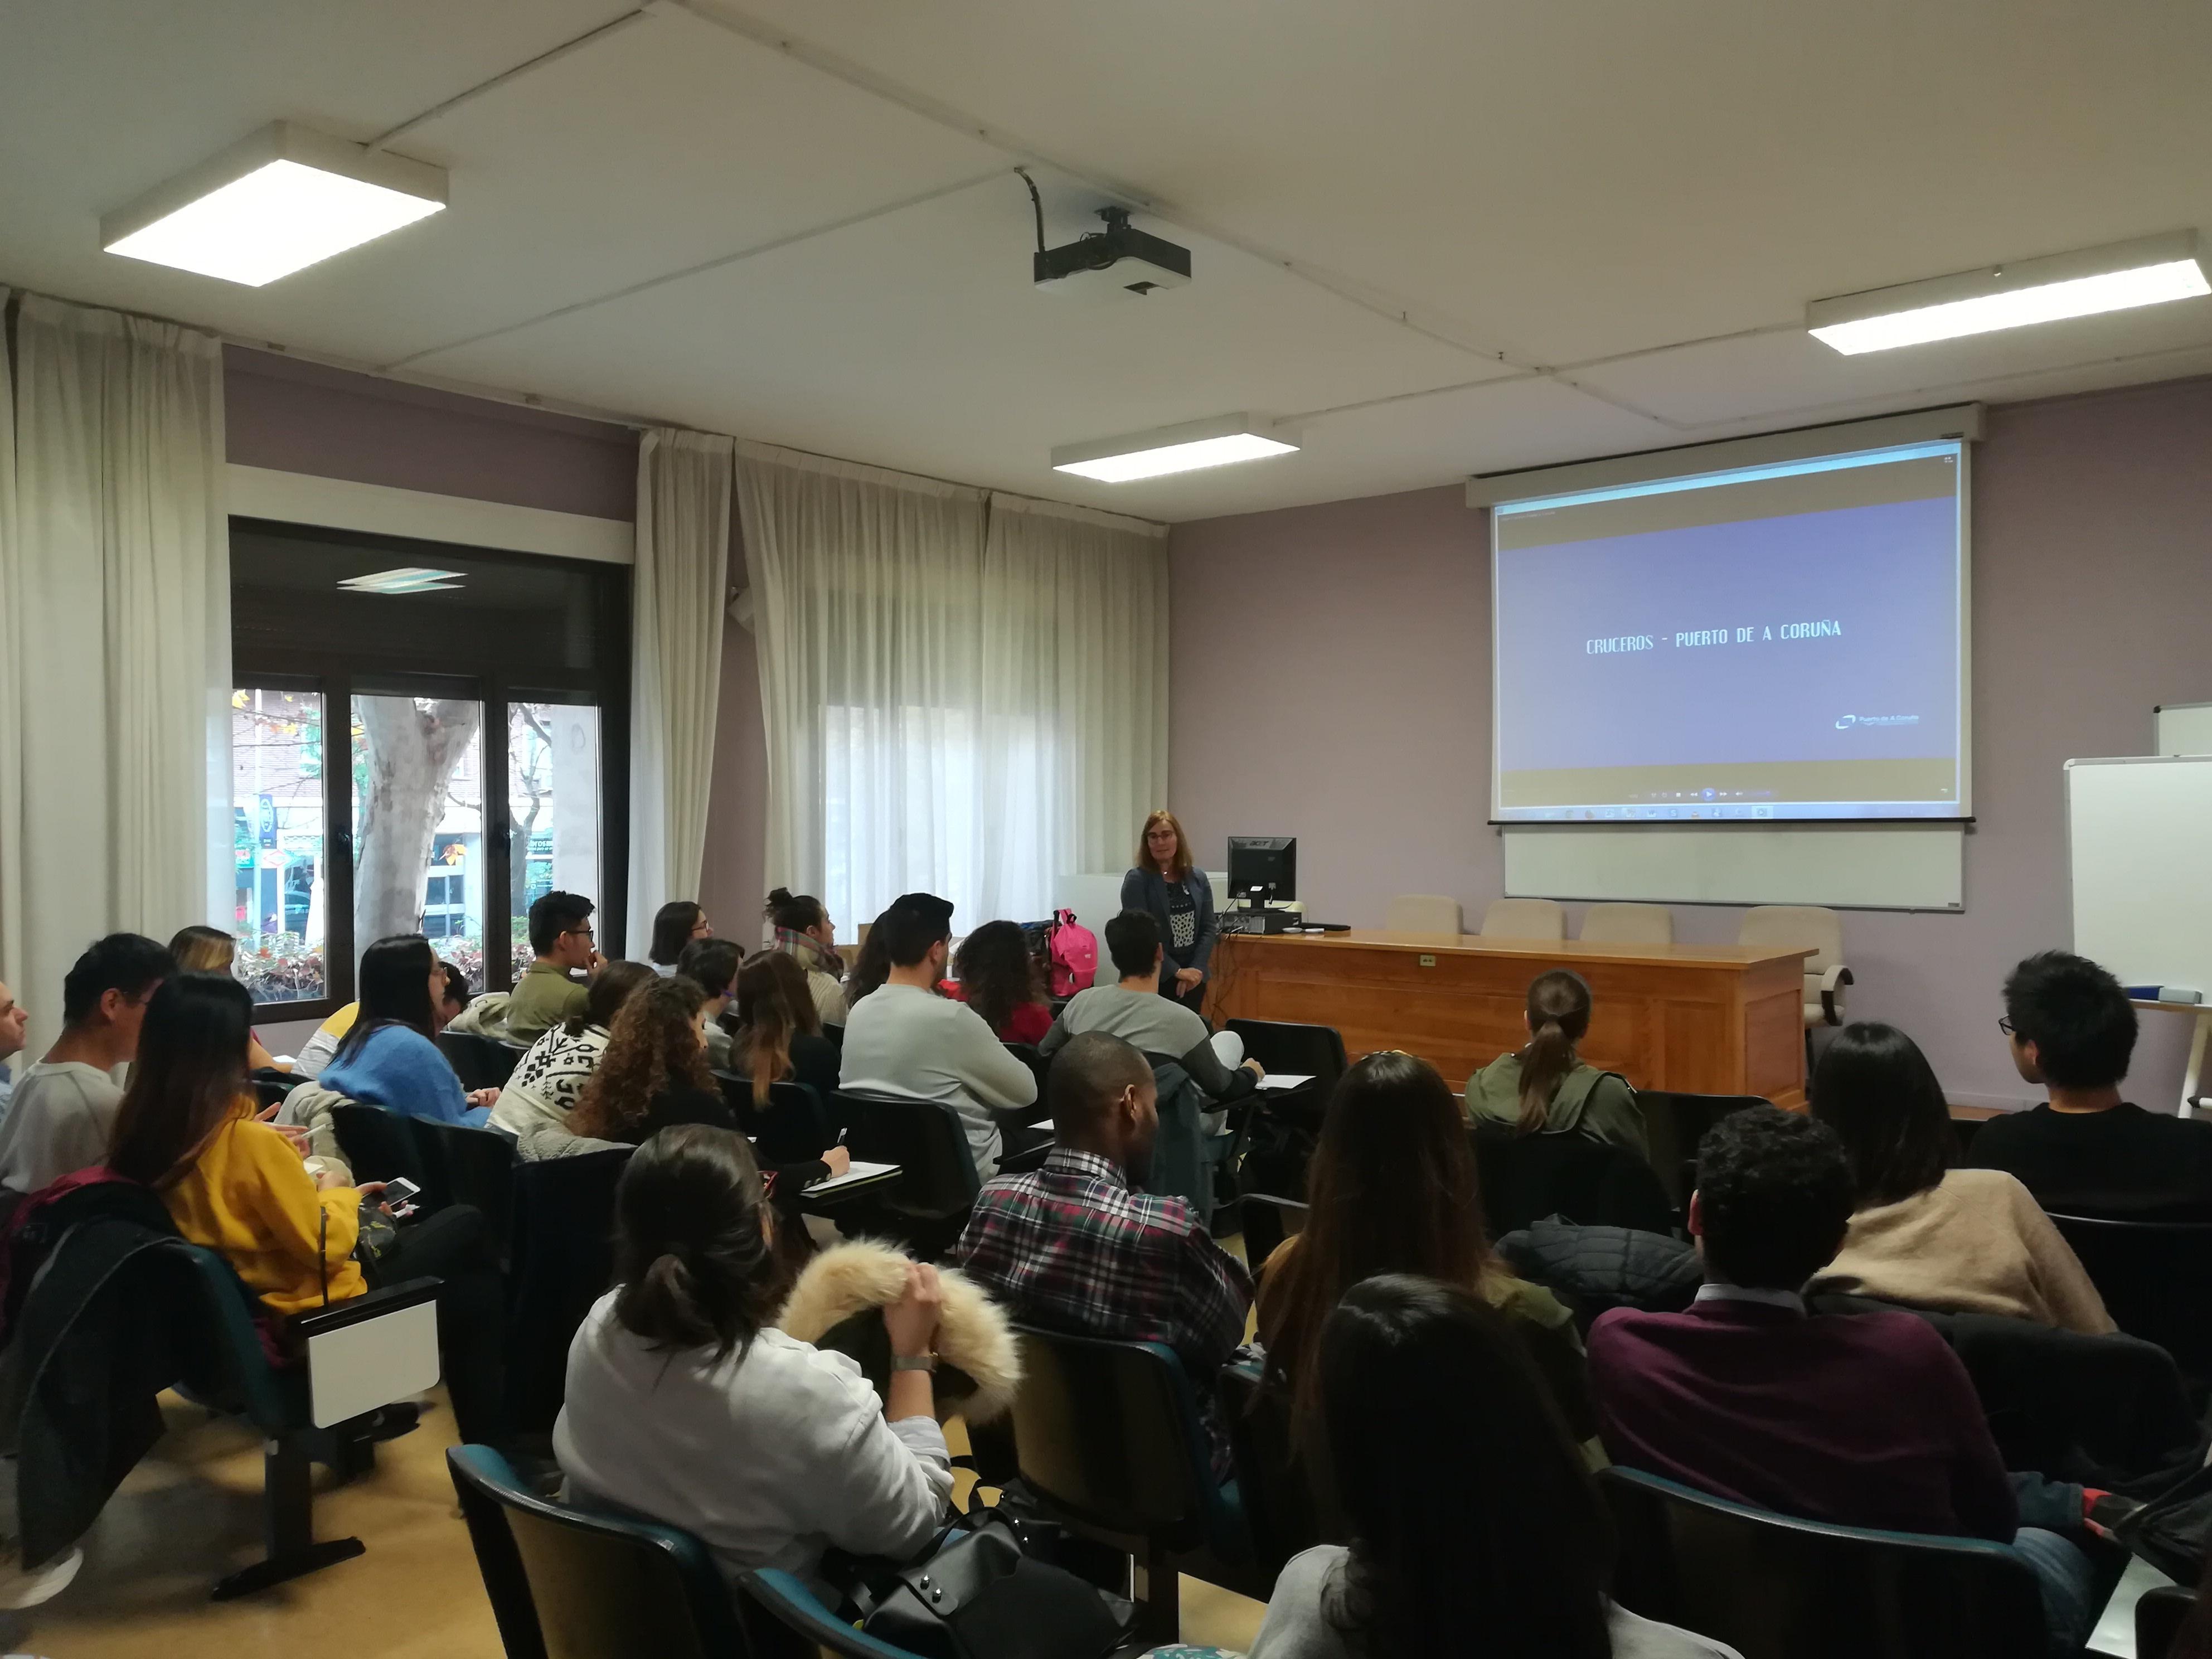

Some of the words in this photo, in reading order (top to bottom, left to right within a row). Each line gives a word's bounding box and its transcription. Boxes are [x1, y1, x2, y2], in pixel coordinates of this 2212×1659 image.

[1587, 635, 1654, 654] CRUCEROS
[1676, 629, 1728, 647] PUERTO
[1736, 627, 1755, 643] DE
[1762, 625, 1772, 641] A
[1780, 619, 1841, 640] CORUÑA
